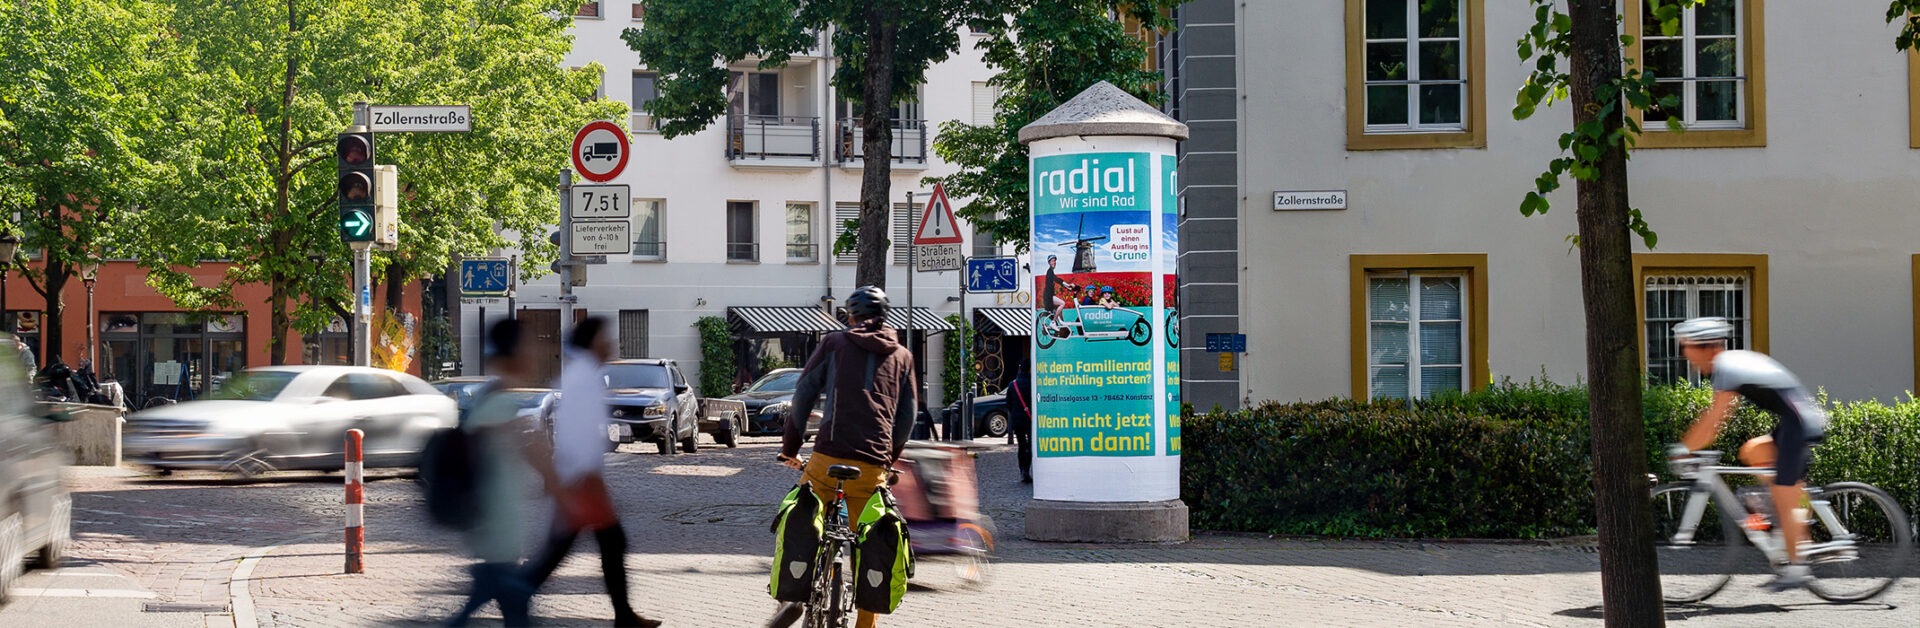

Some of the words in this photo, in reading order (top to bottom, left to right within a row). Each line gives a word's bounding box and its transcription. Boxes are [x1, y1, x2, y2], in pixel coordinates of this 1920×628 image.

[374, 112, 464, 125] Zollernstraße
[1040, 158, 1134, 197] radial
[582, 192, 608, 212] 7,5
[612, 193, 619, 211] t
[1060, 197, 1078, 208] Wir
[1082, 196, 1107, 208] sind
[1112, 195, 1135, 206] Rad
[1278, 195, 1343, 205] Zollernstraße
[921, 246, 956, 256] Straßen-
[922, 257, 956, 267] schäden
[1084, 310, 1112, 320] radial
[1050, 361, 1073, 373] dem
[1076, 359, 1151, 372] Familienrad
[1043, 376, 1058, 386] den
[1060, 374, 1103, 387] Frühling
[1106, 374, 1151, 385] starten?
[1040, 394, 1058, 402] radial
[1038, 415, 1068, 428] Wenn
[1072, 413, 1112, 428] nicht
[1114, 413, 1151, 430] jetzt
[1039, 436, 1084, 452] wann
[1090, 432, 1150, 452] dann!
